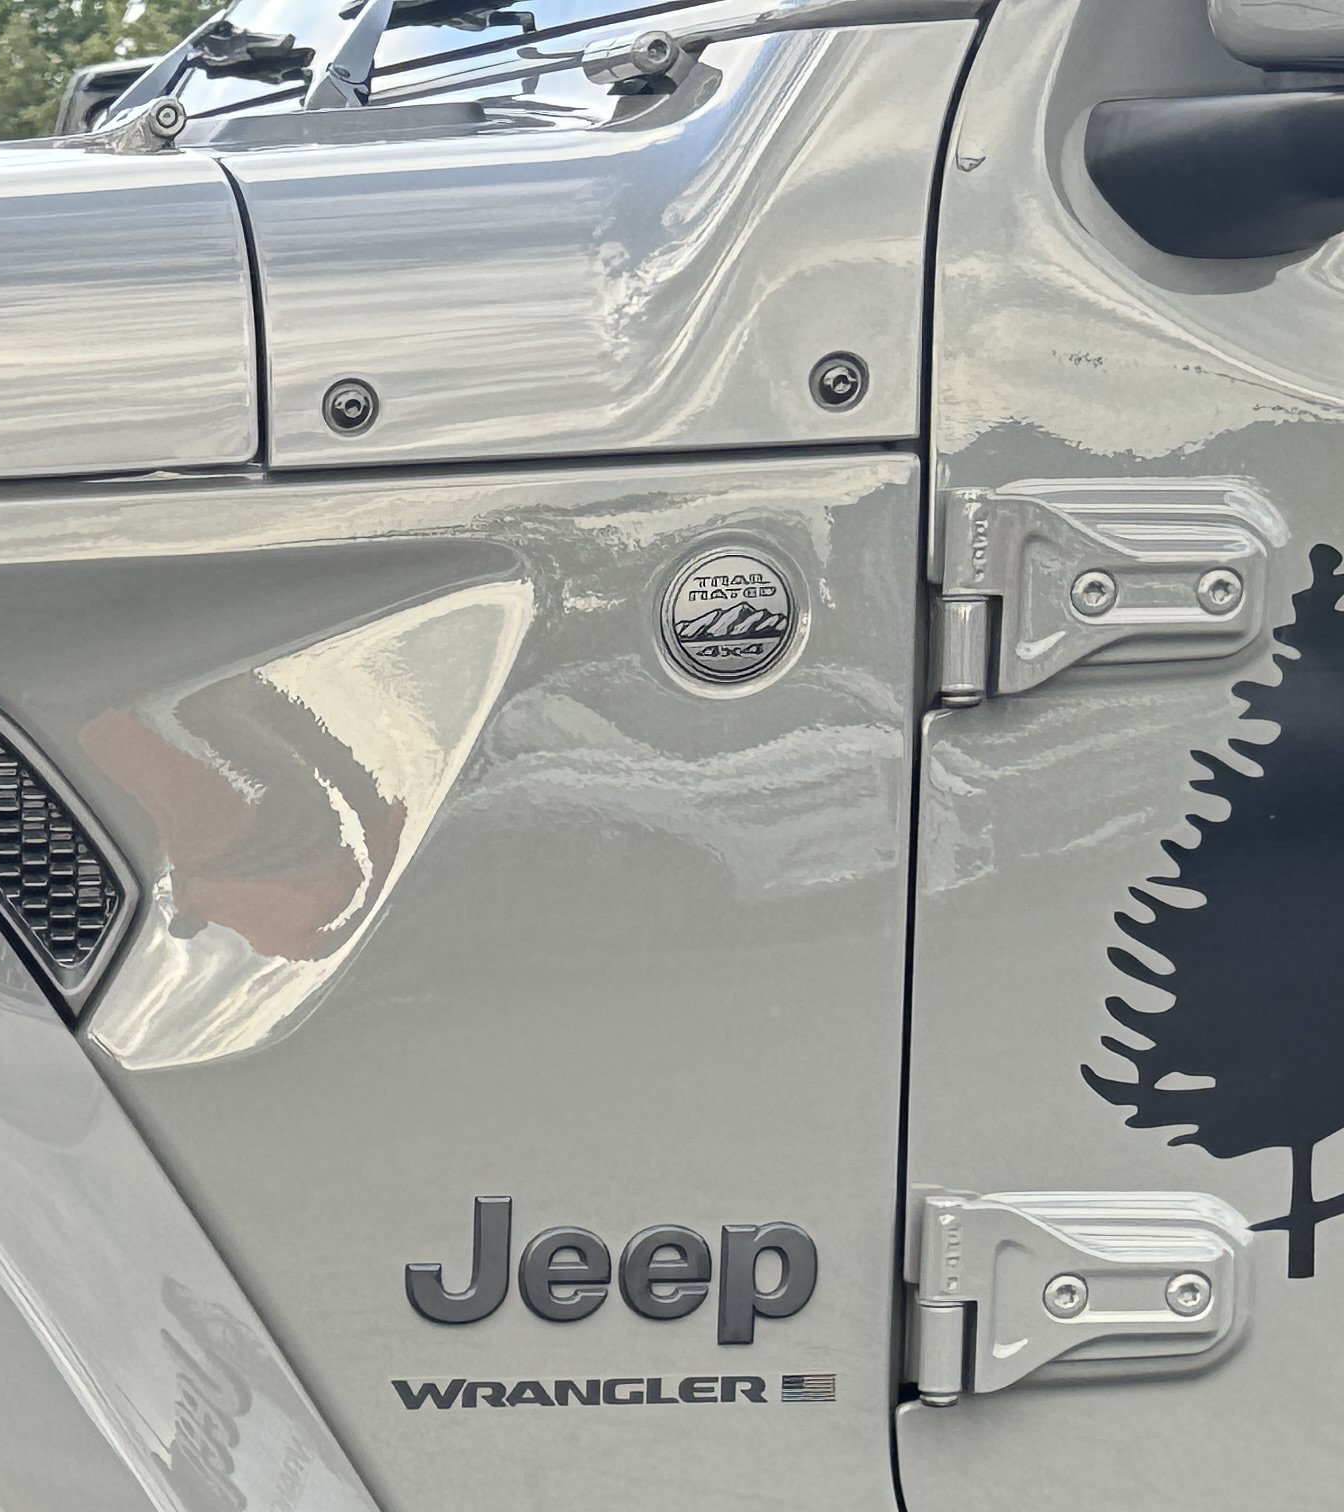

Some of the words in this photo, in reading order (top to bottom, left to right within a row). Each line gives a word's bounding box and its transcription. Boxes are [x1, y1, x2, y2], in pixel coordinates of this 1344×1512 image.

[693, 573, 771, 588] TRAIL
[688, 586, 777, 602] RATED
[404, 1195, 819, 1345] Jeep
[390, 1374, 769, 1411] WRANGLER
